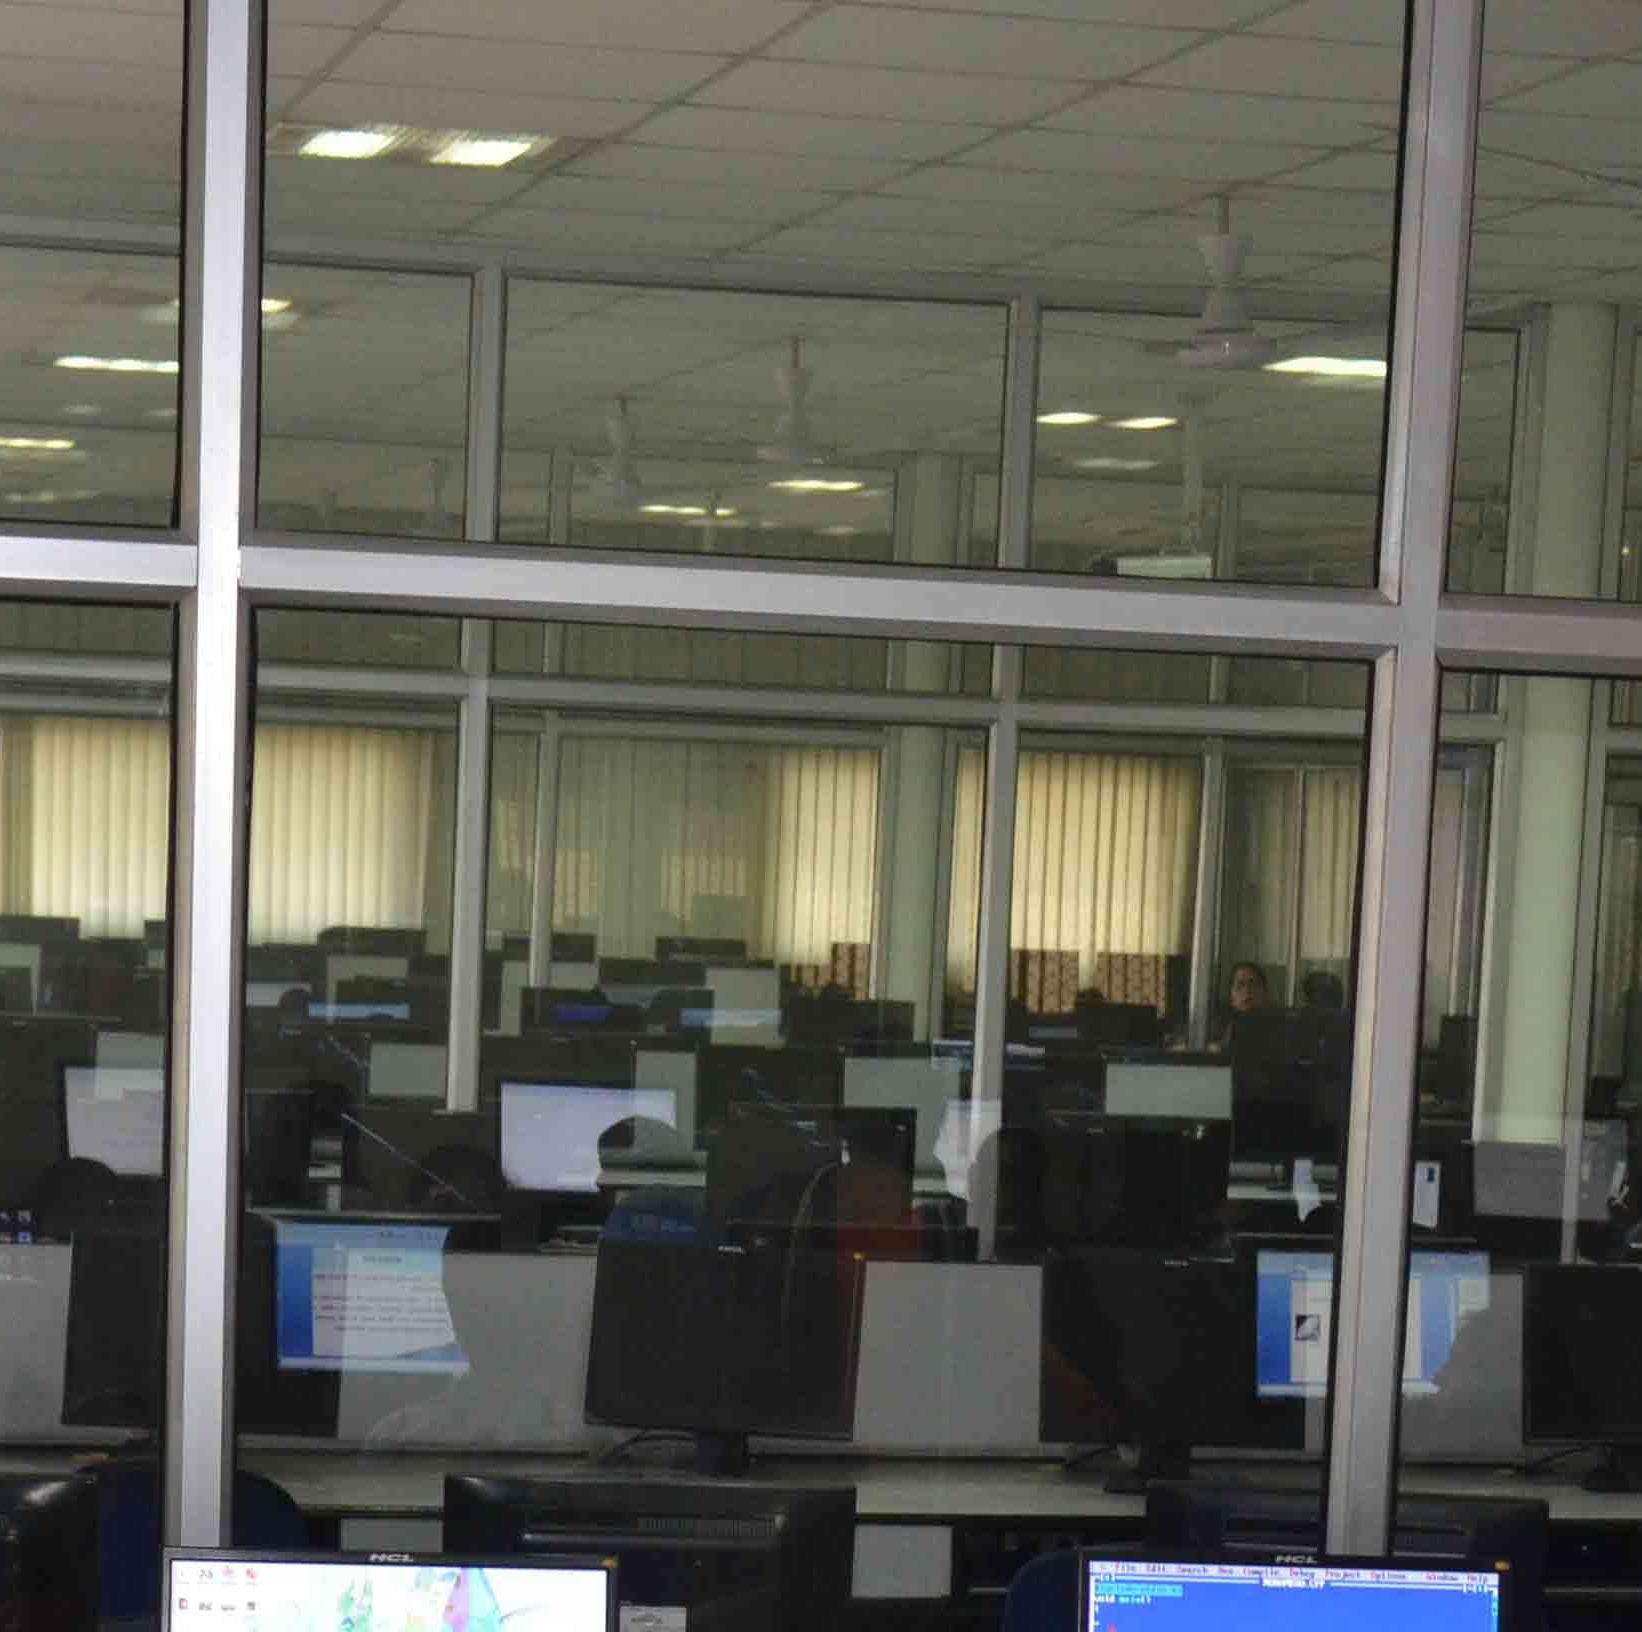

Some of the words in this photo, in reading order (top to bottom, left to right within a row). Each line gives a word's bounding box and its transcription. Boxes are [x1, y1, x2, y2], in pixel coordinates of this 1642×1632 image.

[369, 1553, 415, 1562] HCL
[1274, 1555, 1317, 1564] HCL
[1114, 1561, 1137, 1572] File
[1145, 1563, 1167, 1573] Edit
[1176, 1564, 1209, 1575] Search
[1288, 1568, 1316, 1579] Debug
[1325, 1569, 1361, 1581] Project
[1368, 1570, 1408, 1582] Options
[1426, 1572, 1461, 1583] Window
[1467, 1573, 1489, 1585] Help
